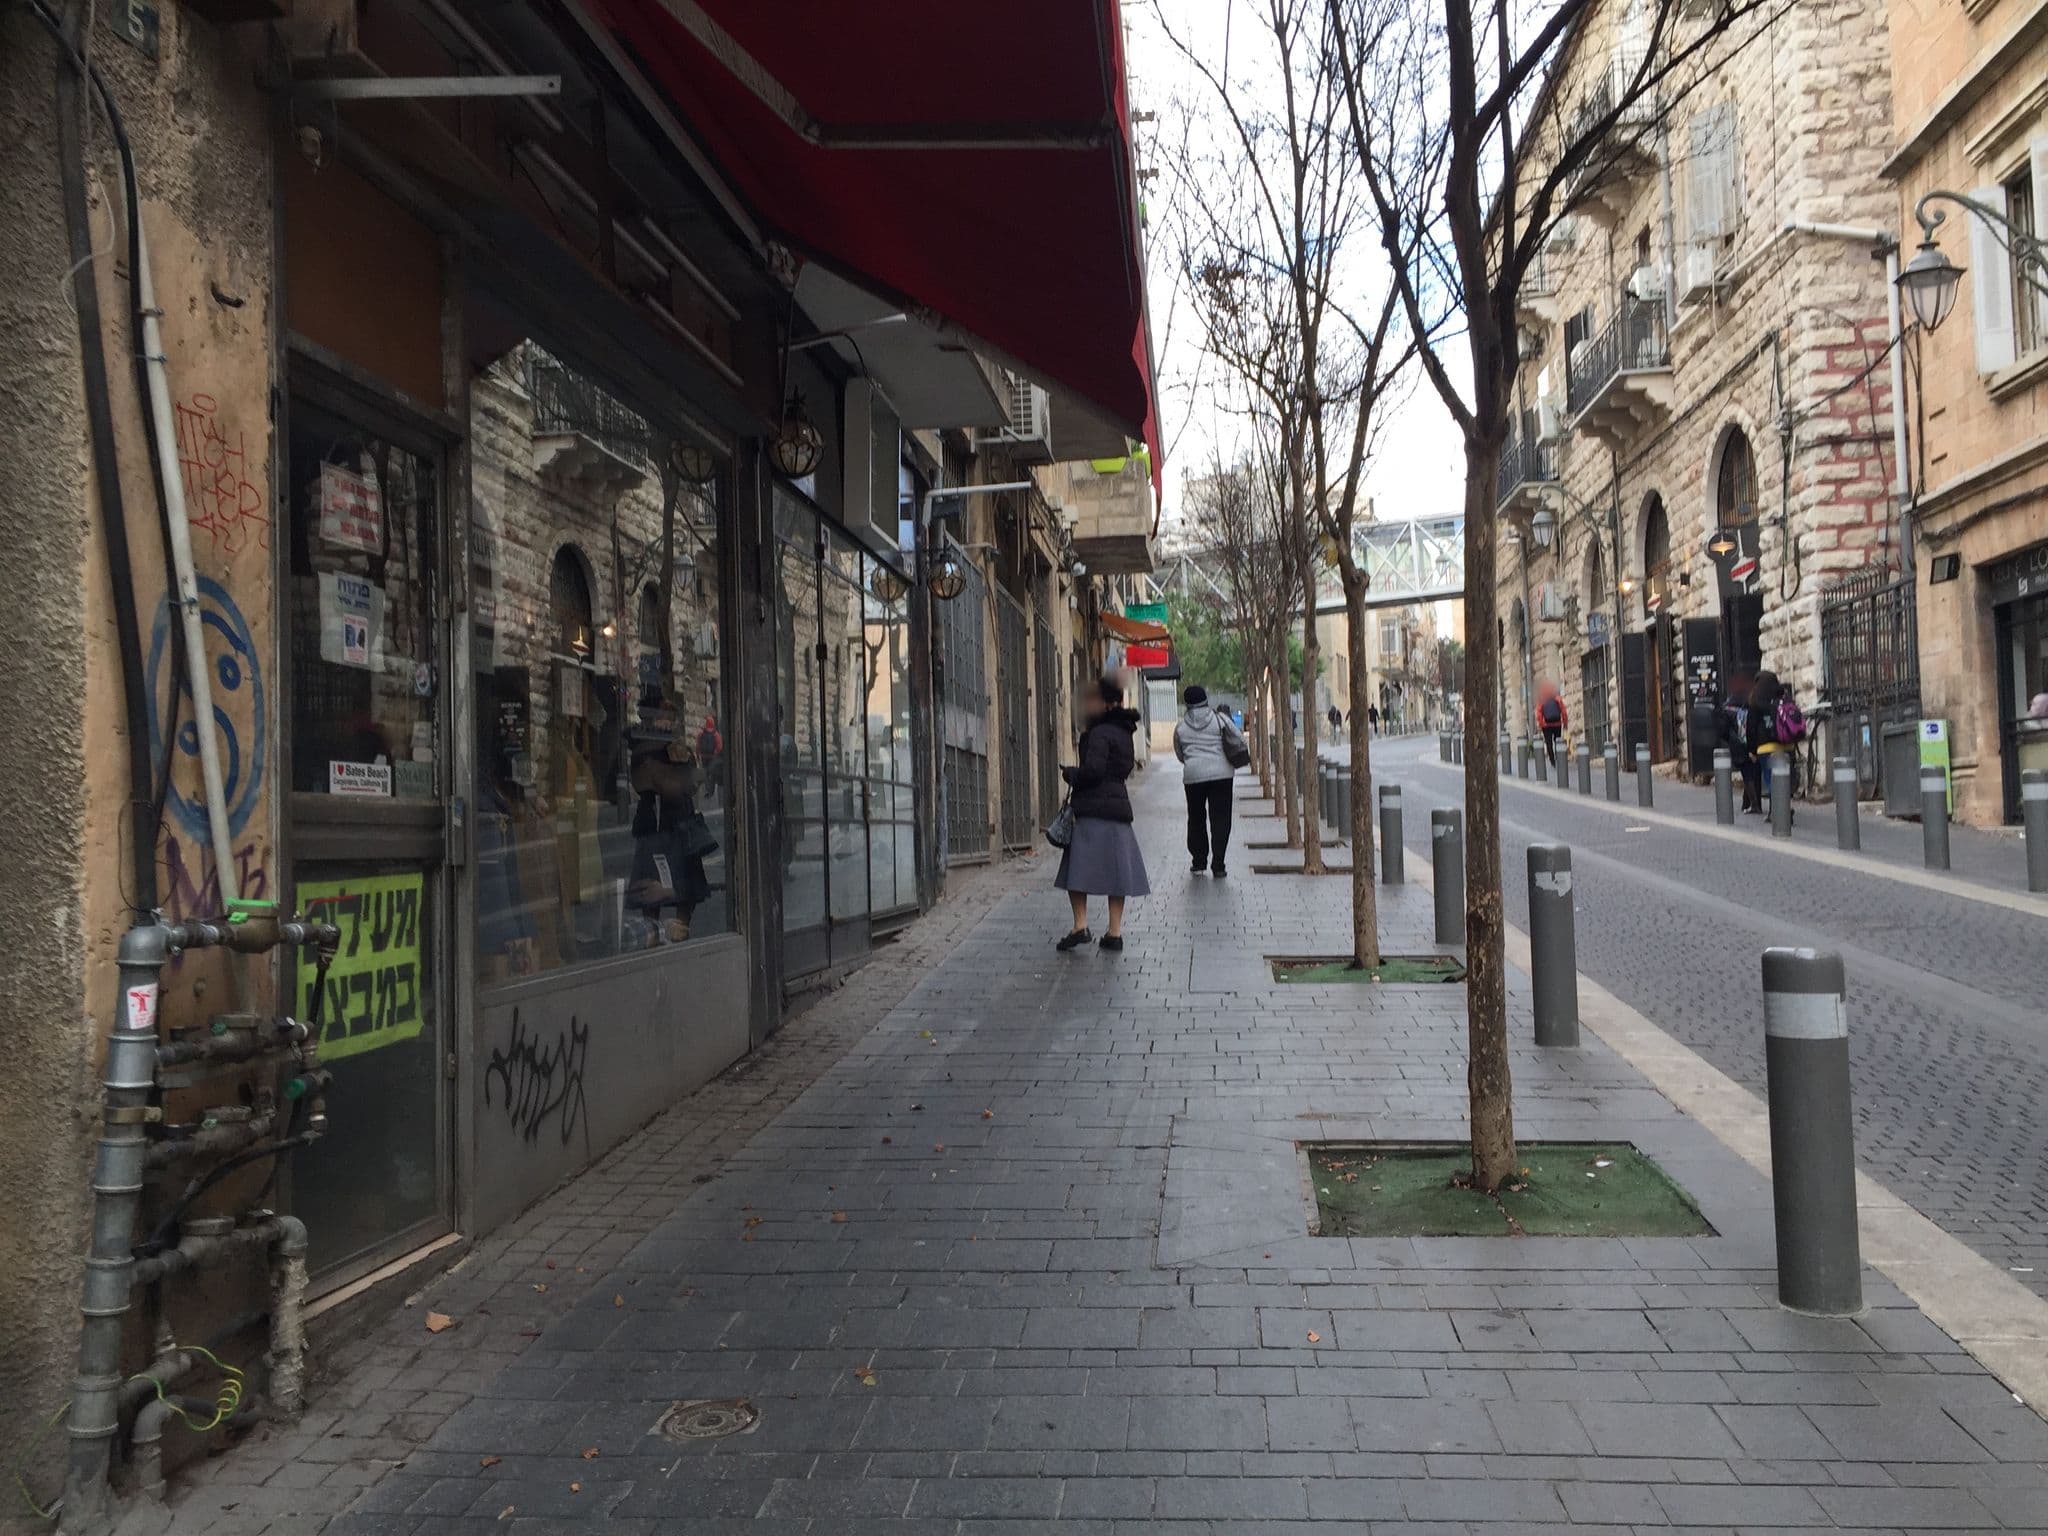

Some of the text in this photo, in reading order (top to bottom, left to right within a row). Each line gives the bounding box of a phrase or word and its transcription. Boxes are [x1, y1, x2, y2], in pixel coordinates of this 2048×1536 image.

[128, 0, 144, 40] 5
[338, 576, 370, 598] פתוח
[345, 764, 366, 777] Bates
[367, 766, 388, 779] Beach
